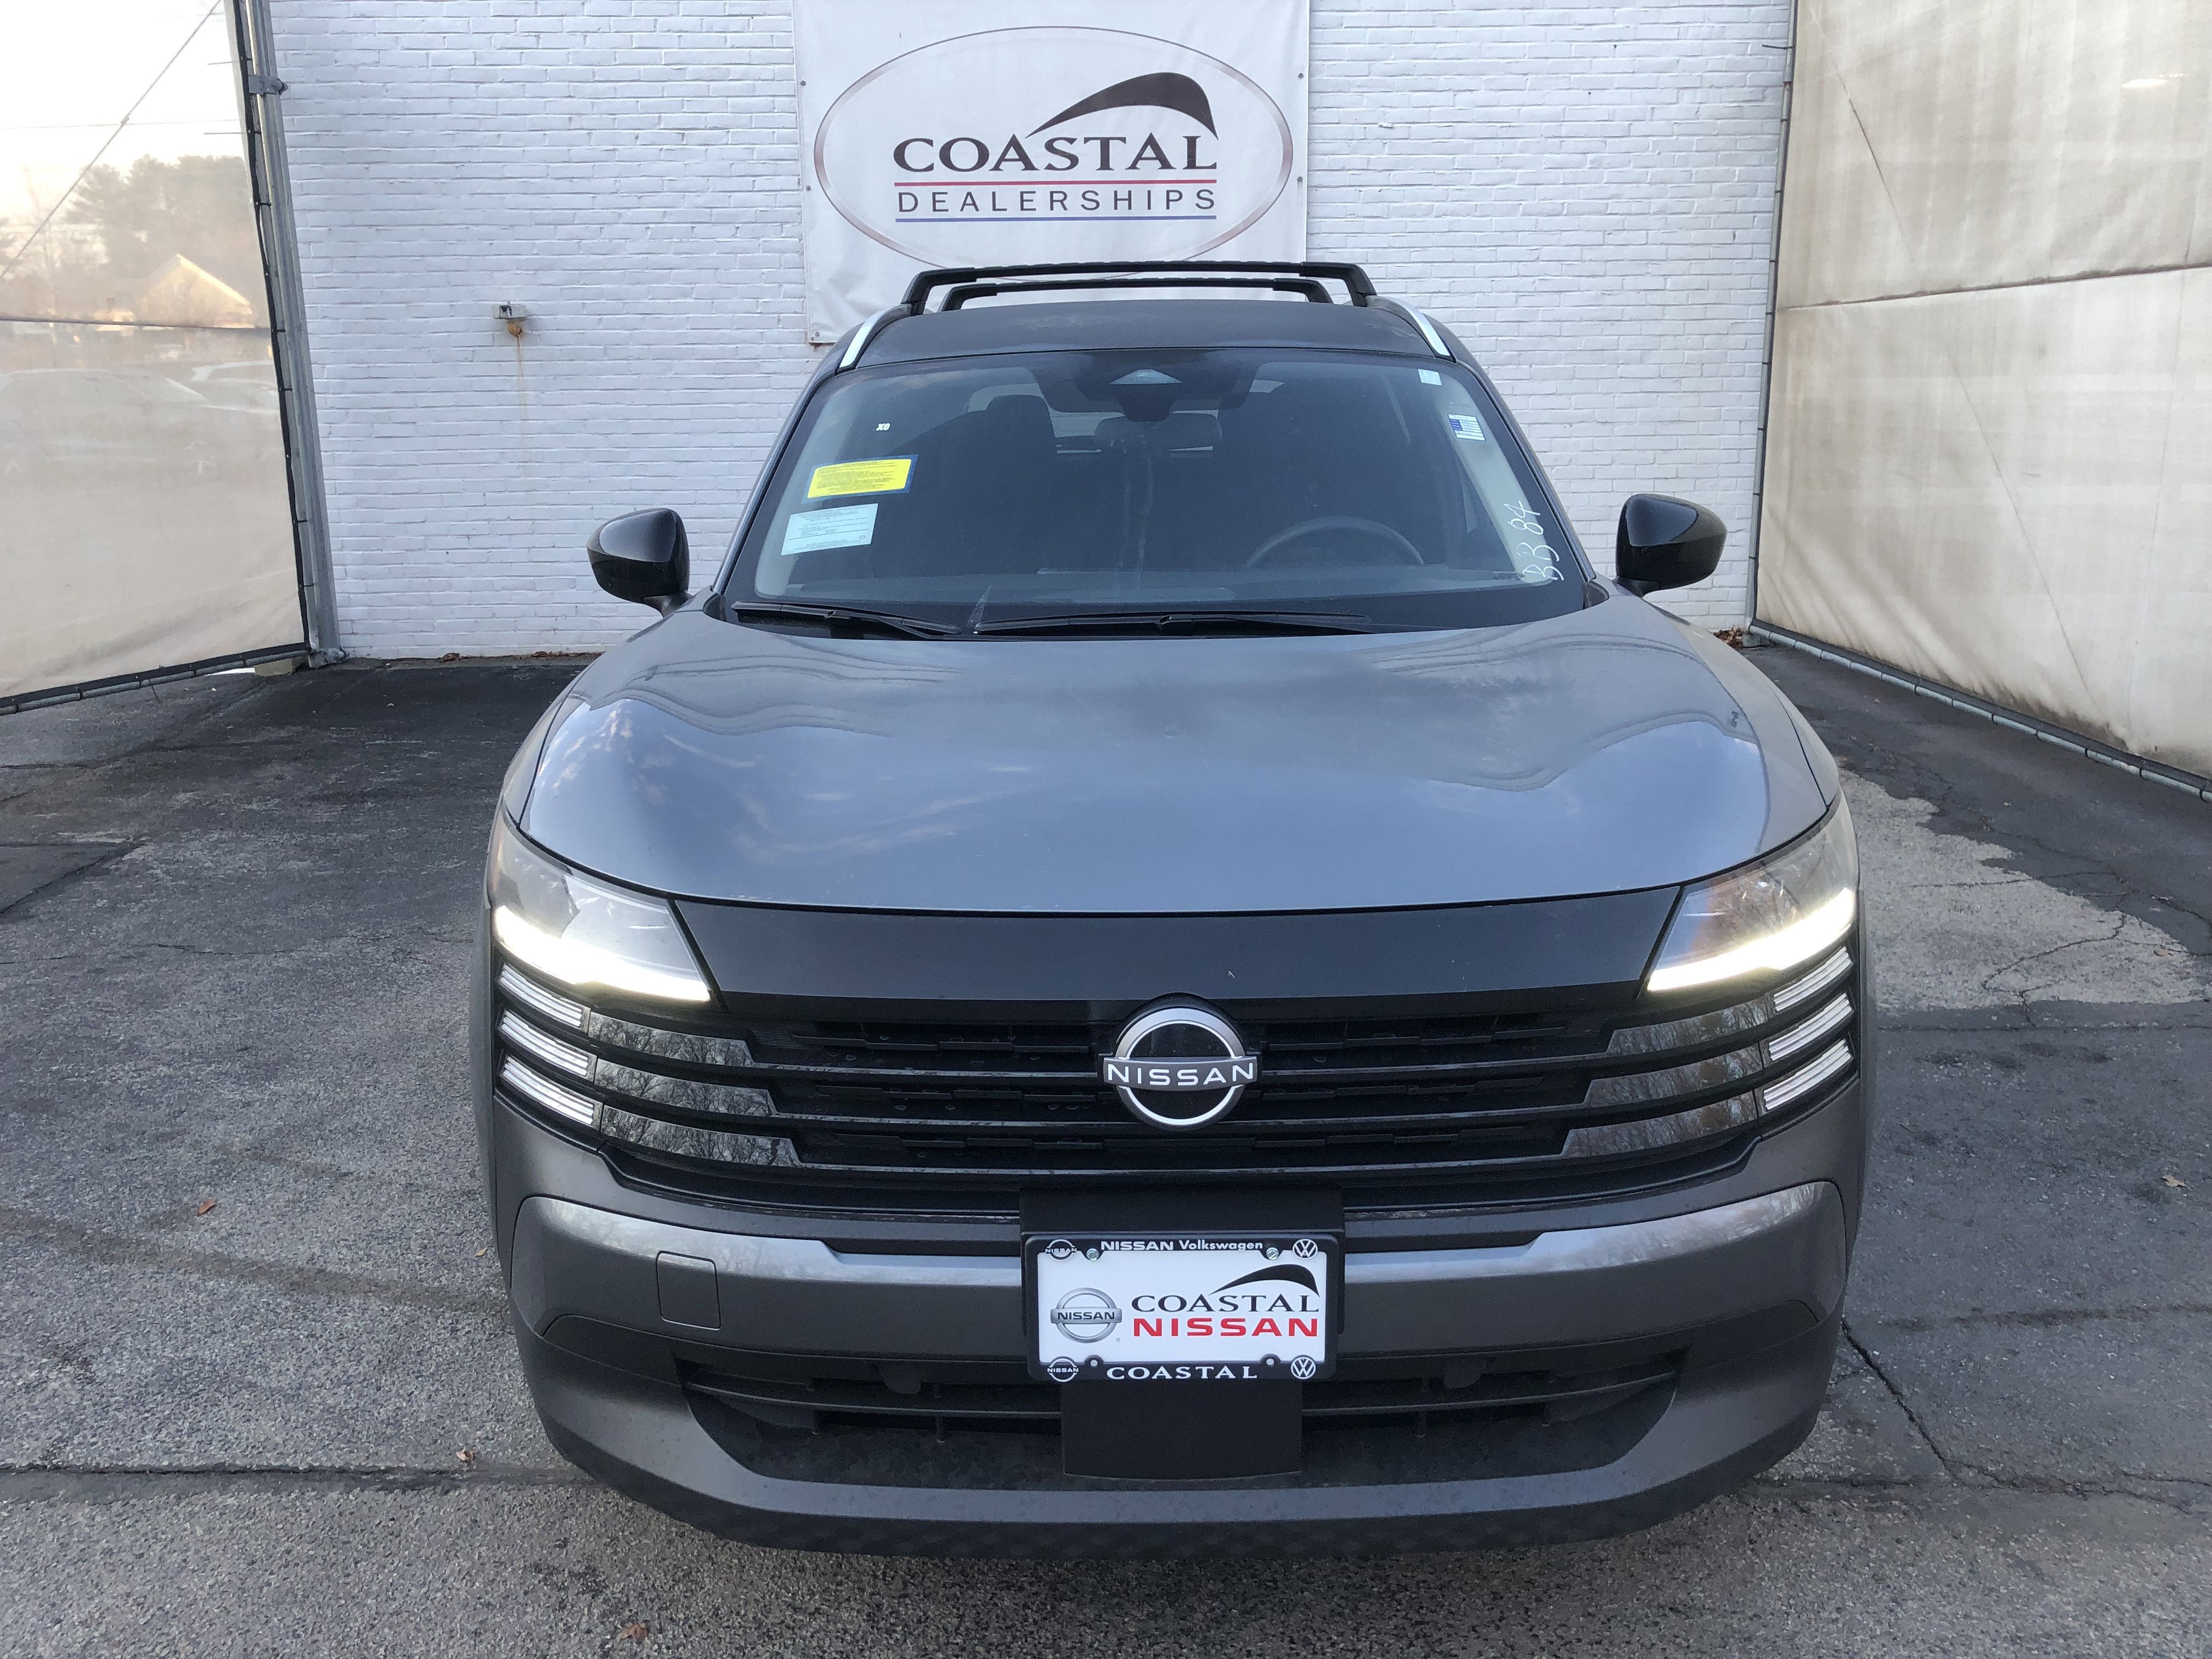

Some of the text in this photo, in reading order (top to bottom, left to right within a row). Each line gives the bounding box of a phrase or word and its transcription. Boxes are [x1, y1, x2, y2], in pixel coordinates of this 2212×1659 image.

[893, 132, 1217, 172] COASTAL
[898, 189, 1216, 212] DEALERSHIPS
[1107, 1062, 1254, 1086] NISSAN
[1101, 1240, 1263, 1251] NISSAN Volkswagen
[1131, 1293, 1319, 1312] COASTAL
[1058, 1312, 1115, 1320] NISSAN
[1133, 1318, 1317, 1336] NISSAN
[1107, 1365, 1257, 1379] COASTAL
